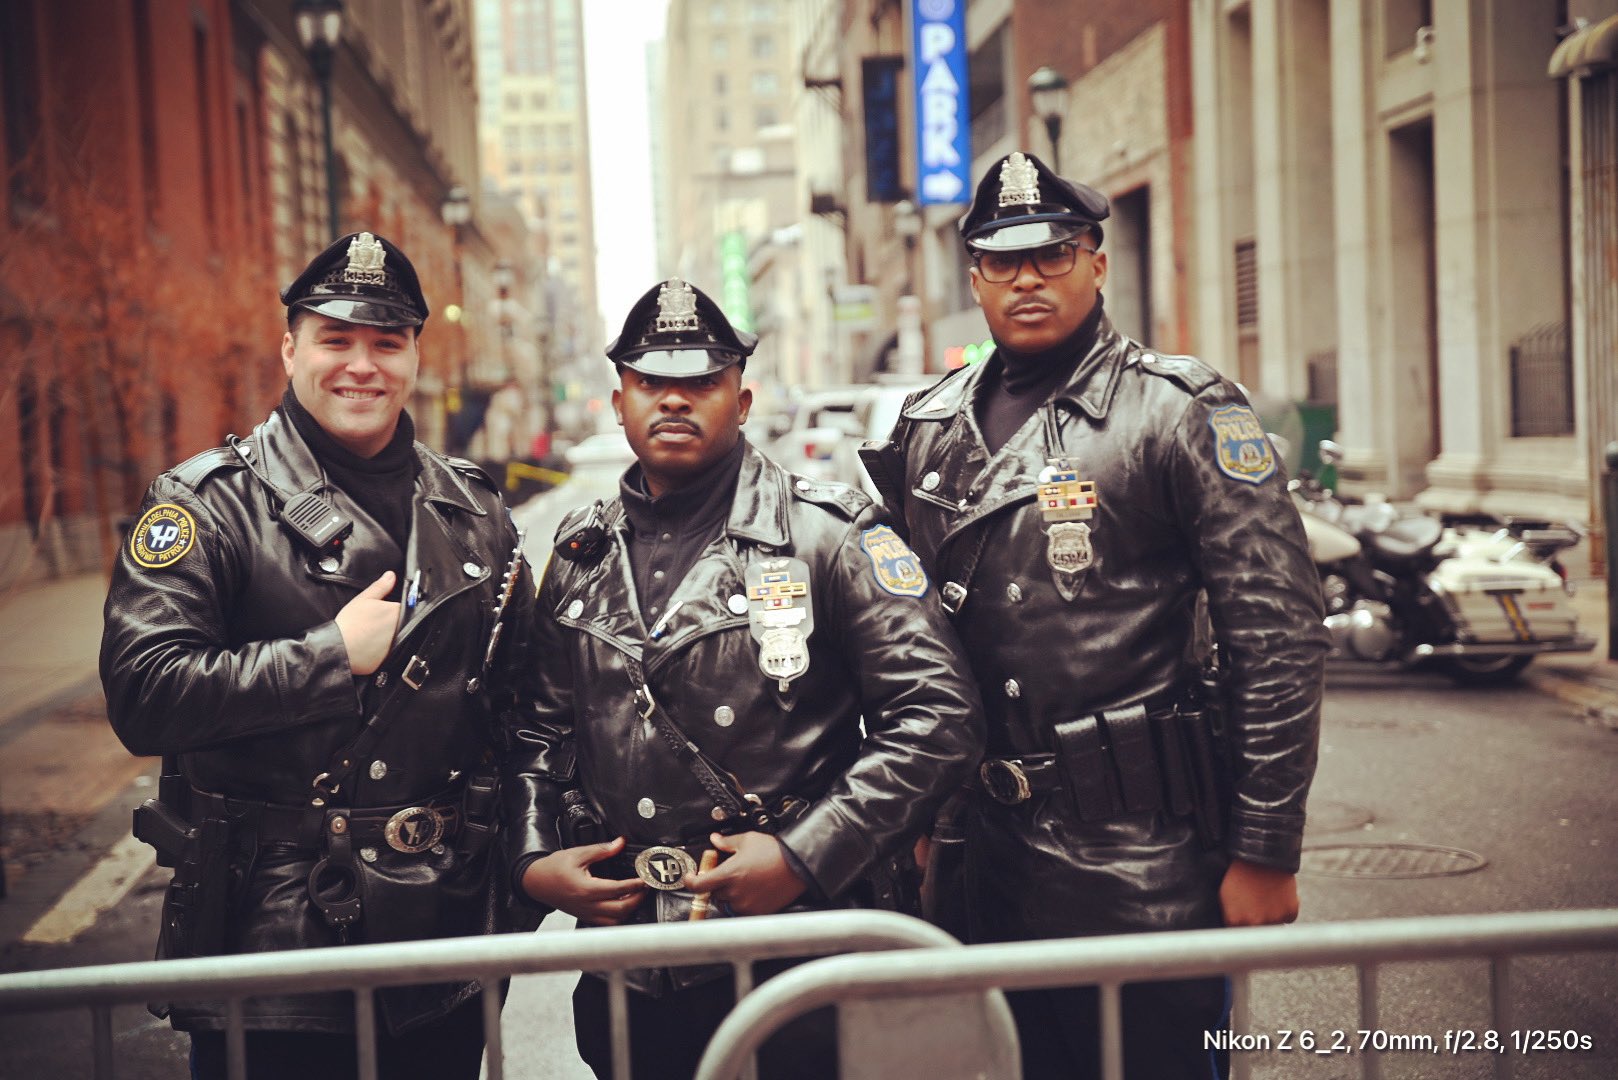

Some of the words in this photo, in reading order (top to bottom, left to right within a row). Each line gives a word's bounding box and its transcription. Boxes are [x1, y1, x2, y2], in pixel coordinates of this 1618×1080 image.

[920, 22, 960, 168] PARK
[137, 508, 179, 538] PHILADELPHIA
[177, 516, 190, 540] POLICE
[150, 524, 179, 549] HP
[136, 543, 157, 562] HIGHWAY
[158, 543, 185, 562] PATROL
